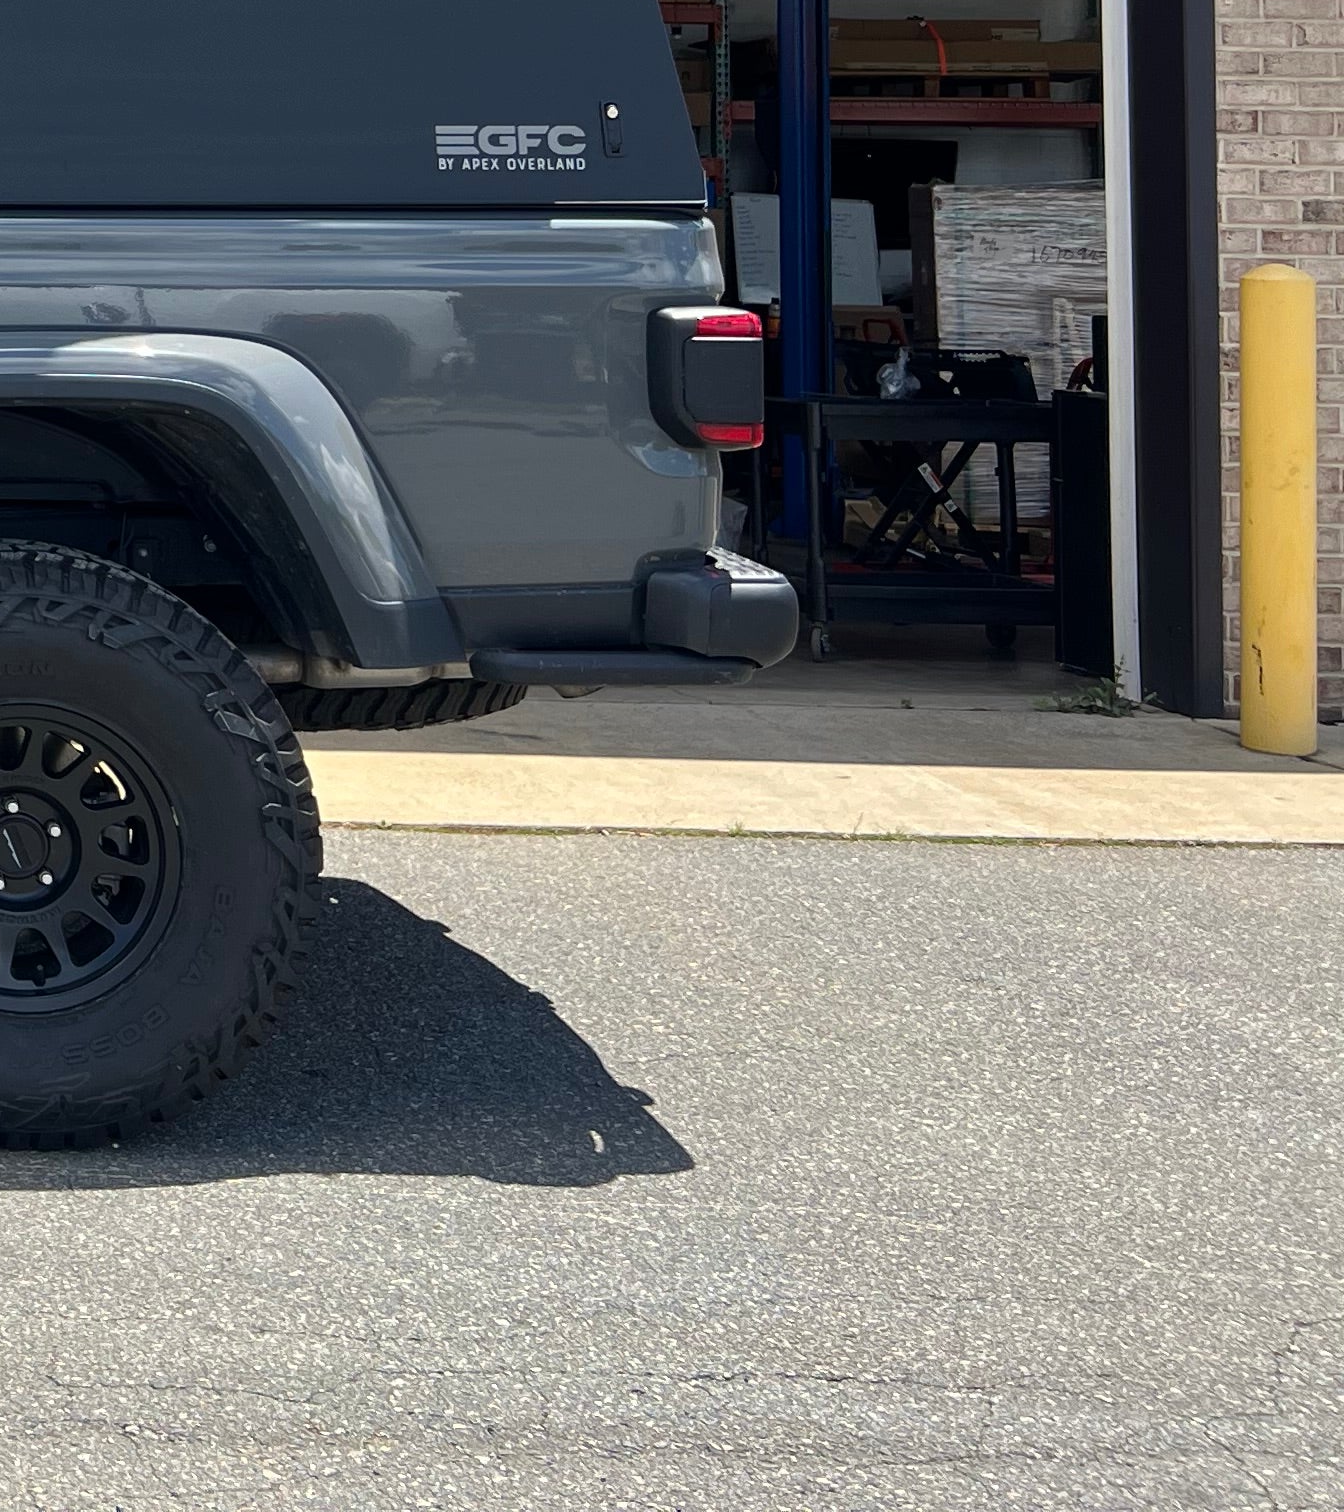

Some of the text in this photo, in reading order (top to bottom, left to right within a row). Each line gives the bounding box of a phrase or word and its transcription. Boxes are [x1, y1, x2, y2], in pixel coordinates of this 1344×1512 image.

[438, 158, 587, 171] BY APEX OVERLAND
[61, 1002, 170, 1066] BOSS
